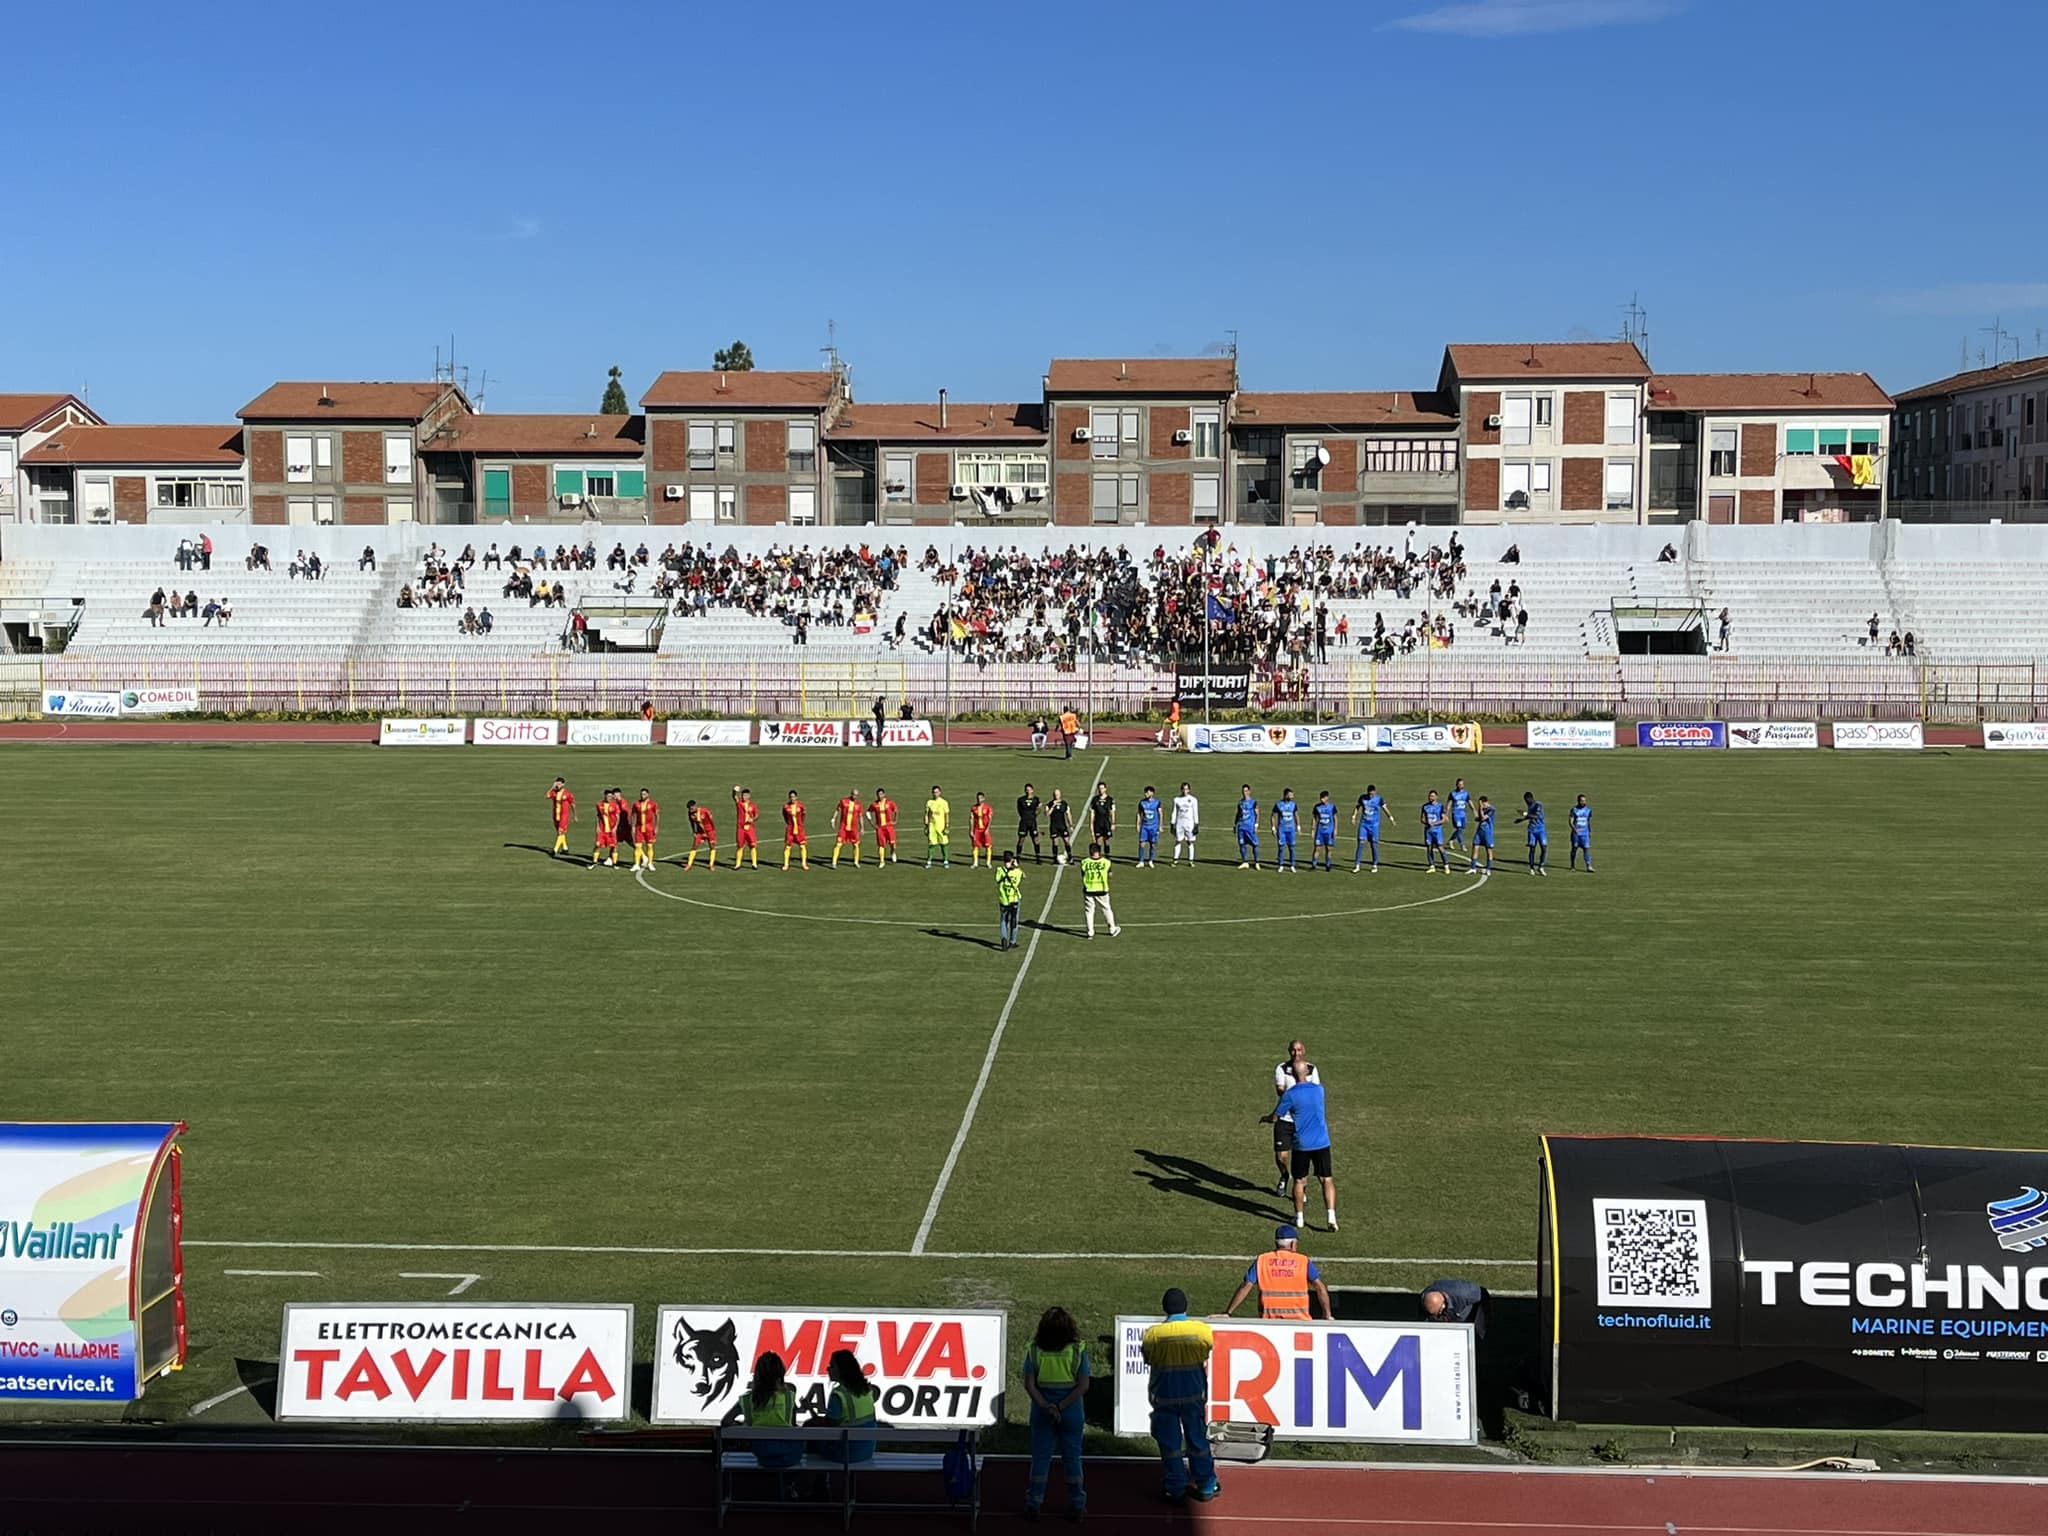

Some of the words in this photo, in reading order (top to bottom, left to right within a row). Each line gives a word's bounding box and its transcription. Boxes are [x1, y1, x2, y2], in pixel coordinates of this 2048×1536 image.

[140, 691, 194, 703] COMEDIL
[482, 721, 549, 740] Saitta
[783, 722, 839, 735] ME.VA.
[1577, 728, 1612, 737] Vaillant
[1663, 728, 1712, 739] sigma
[571, 732, 649, 743] Costantino
[782, 736, 838, 744] TRASPORTI
[1211, 733, 1247, 742] ESSE
[1251, 733, 1262, 742] B
[1311, 732, 1347, 741] ESSE
[1352, 731, 1362, 740] B
[1392, 731, 1430, 740] ESSE
[1434, 731, 1444, 740] B
[1764, 730, 1815, 740] Pasquale
[11, 1221, 123, 1260] Vaillant
[1598, 1313, 1711, 1329] technofluid.it
[1851, 1318, 1935, 1335] MARINE
[318, 1320, 577, 1341] ELETTROMECCANICA
[0, 1341, 39, 1358] TVCC
[54, 1342, 120, 1359] ALLARME
[750, 1319, 988, 1380] ME.VA.
[294, 1346, 616, 1402] TAVILLA
